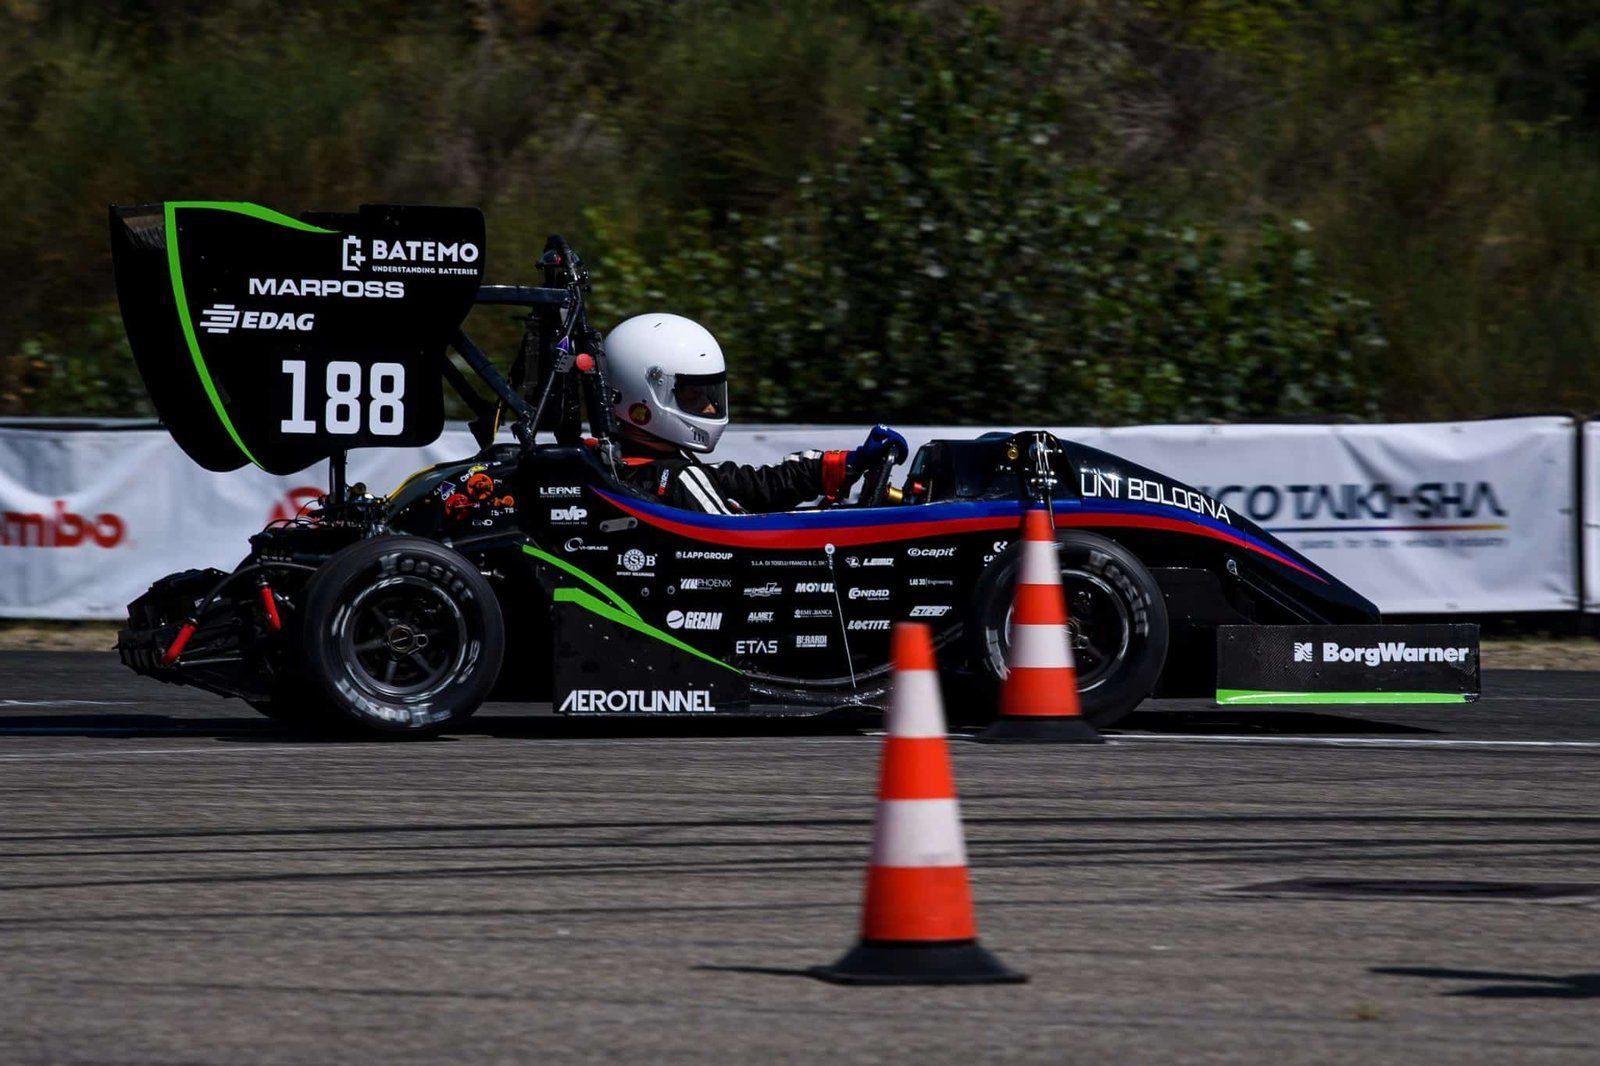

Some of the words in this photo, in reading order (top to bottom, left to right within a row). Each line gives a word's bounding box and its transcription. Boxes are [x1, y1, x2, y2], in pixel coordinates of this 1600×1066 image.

[373, 240, 479, 262] BATEMO
[372, 265, 436, 274] UNDERSTANDING
[438, 267, 478, 275] BATTERIES
[249, 278, 405, 298] MARPOSS
[241, 311, 315, 331] EDAG
[281, 360, 405, 436] 188
[1080, 472, 1120, 499] UNI
[1127, 477, 1231, 525] BOLOGNA
[682, 551, 704, 560] LAPP
[704, 552, 733, 561] GROUP
[921, 547, 955, 558] capit
[698, 578, 732, 588] PHOENIX
[795, 582, 836, 593] MOTUL
[848, 587, 890, 600] CONRAD
[684, 611, 723, 630] GECAM
[847, 620, 890, 630] LOCTITE
[736, 640, 778, 654] ETAS
[1322, 642, 1469, 667] BorgWarner
[559, 690, 716, 712] AEROTUNNEL
